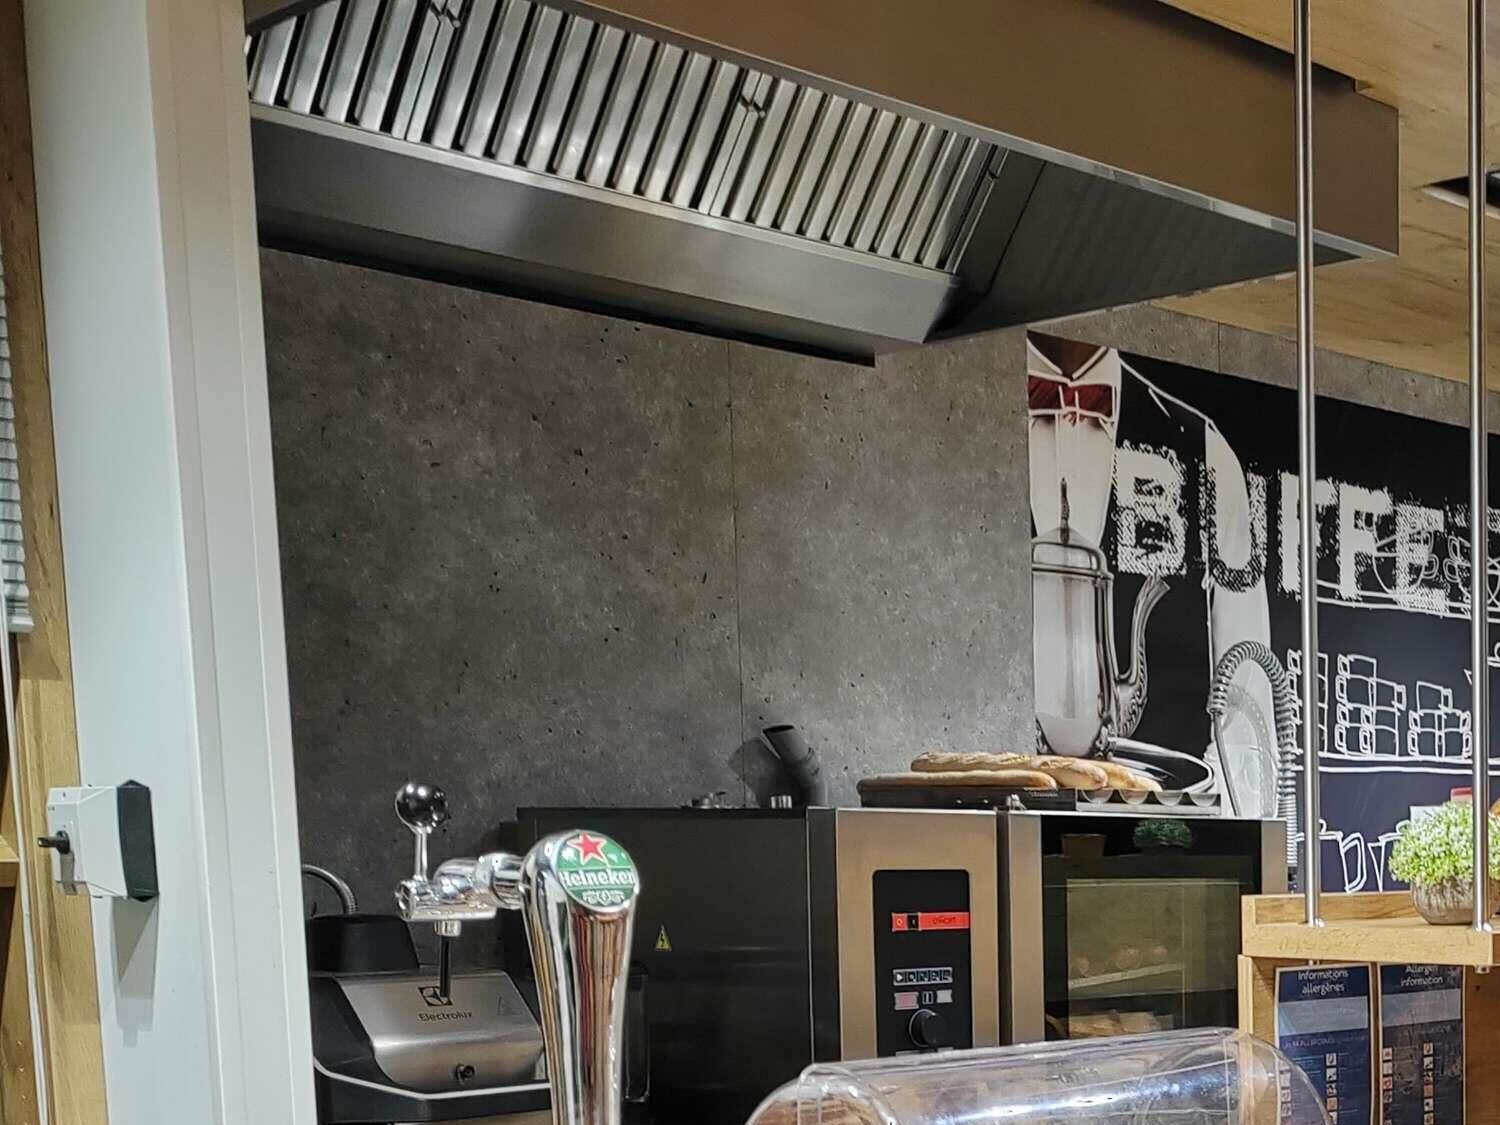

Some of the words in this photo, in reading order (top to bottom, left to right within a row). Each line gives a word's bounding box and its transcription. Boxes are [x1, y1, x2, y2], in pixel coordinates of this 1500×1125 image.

[559, 866, 634, 888] Heineken
[1298, 969, 1349, 981] Informations
[1302, 983, 1345, 995] allergènes
